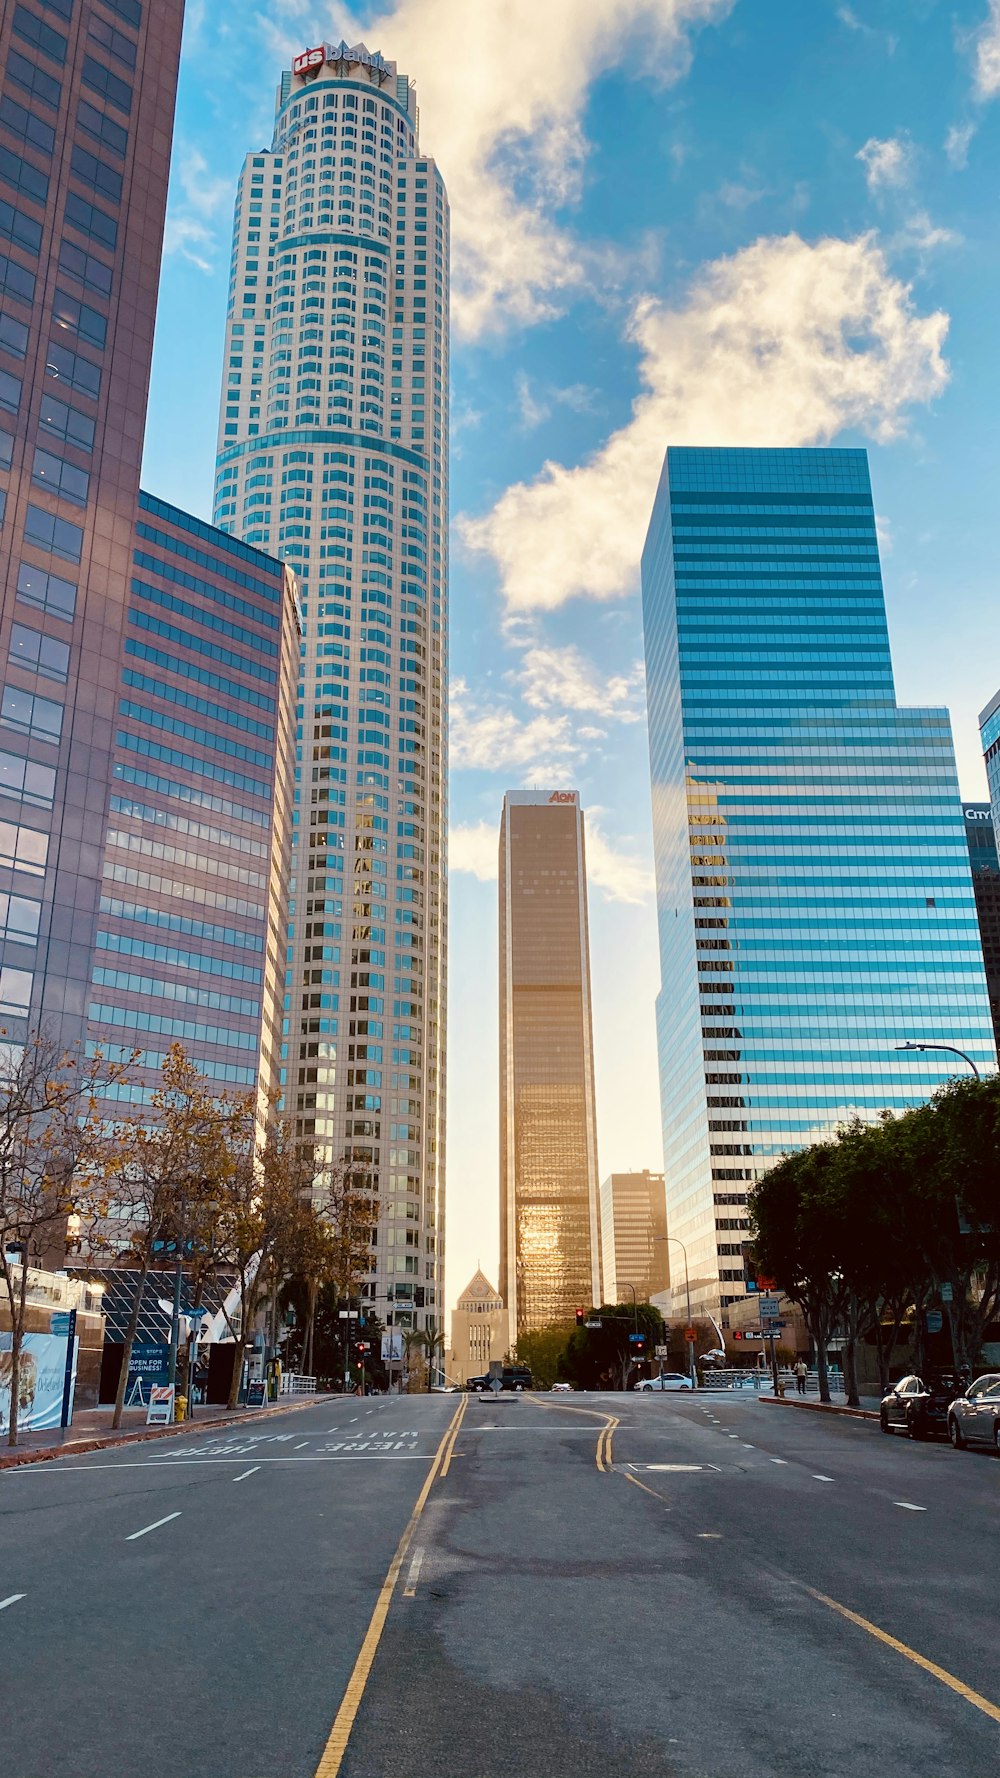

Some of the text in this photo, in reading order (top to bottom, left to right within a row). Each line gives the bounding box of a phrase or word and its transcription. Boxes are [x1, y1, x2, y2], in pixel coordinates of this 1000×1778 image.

[326, 46, 392, 75] bank
[346, 1431, 419, 1439] WAIT
[315, 1441, 419, 1451] HERE
